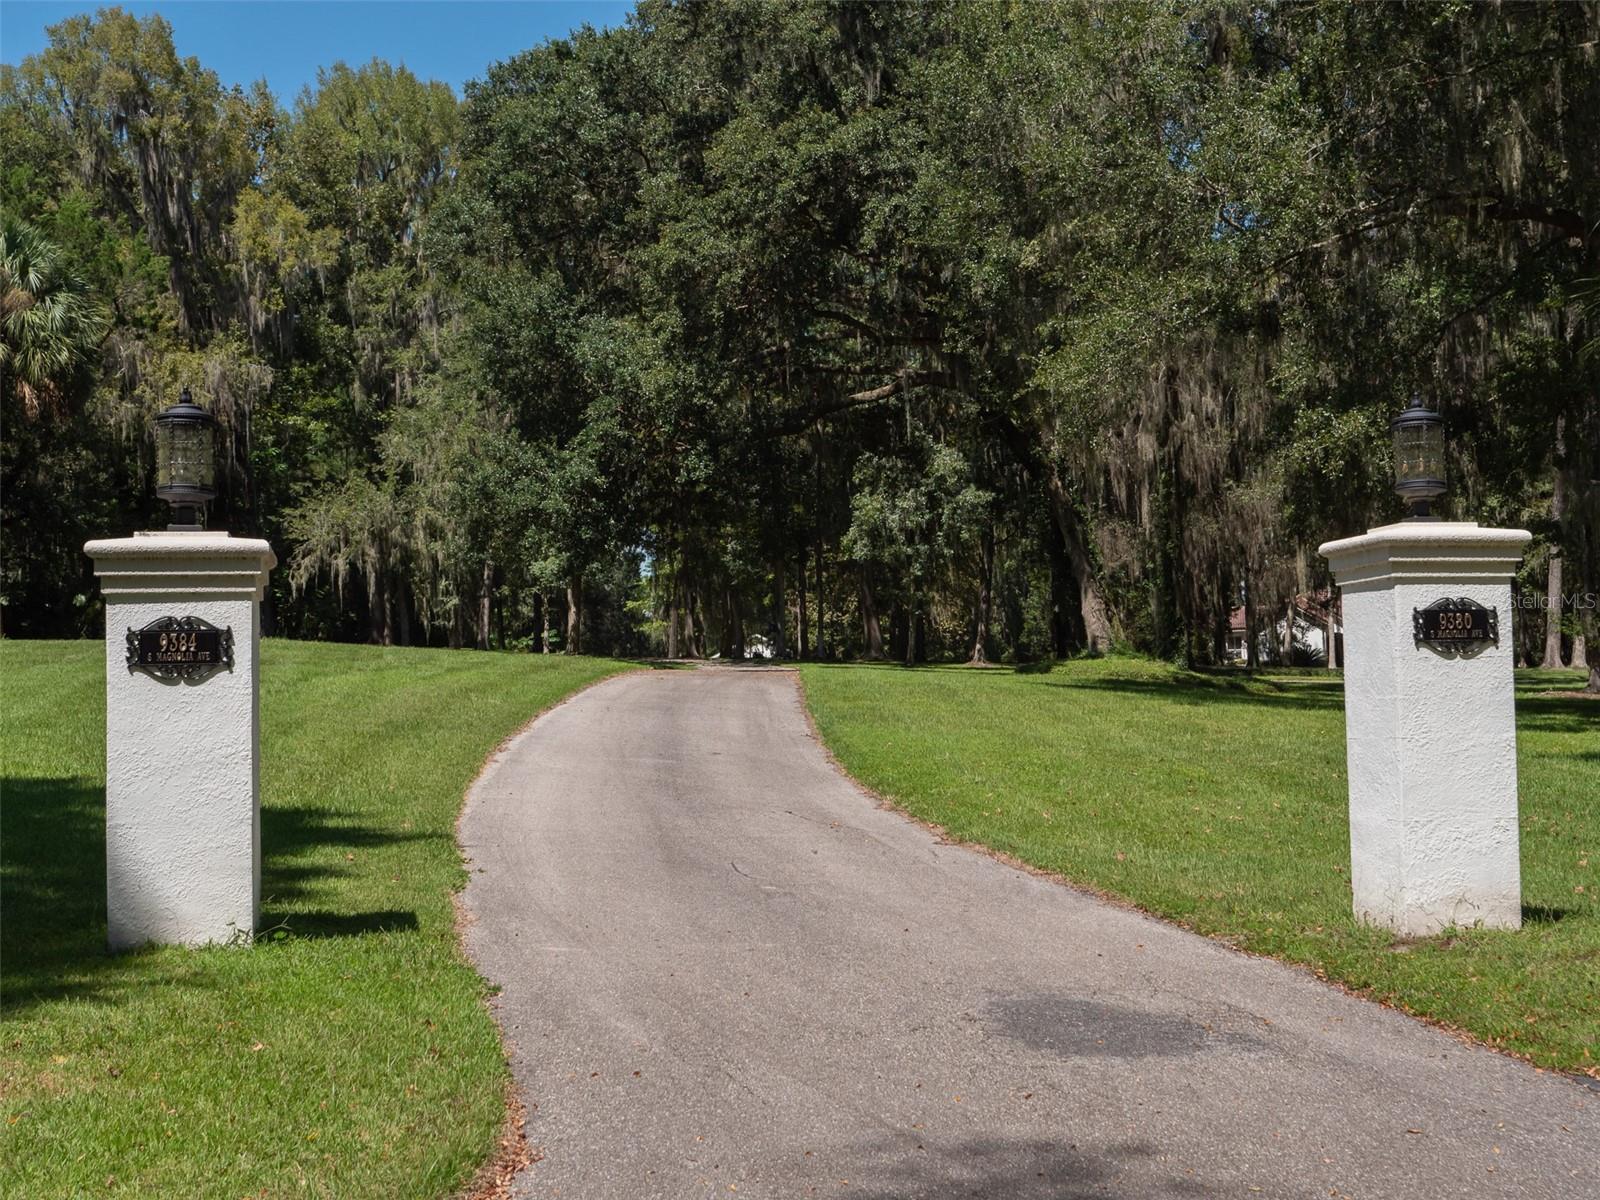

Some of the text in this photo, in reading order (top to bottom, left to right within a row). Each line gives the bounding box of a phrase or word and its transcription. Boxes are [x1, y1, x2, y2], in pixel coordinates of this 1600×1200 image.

[1439, 612, 1472, 630] 9380
[159, 633, 198, 652] 9384
[156, 652, 194, 661] MAGNOLIA
[198, 651, 210, 660] AVE
